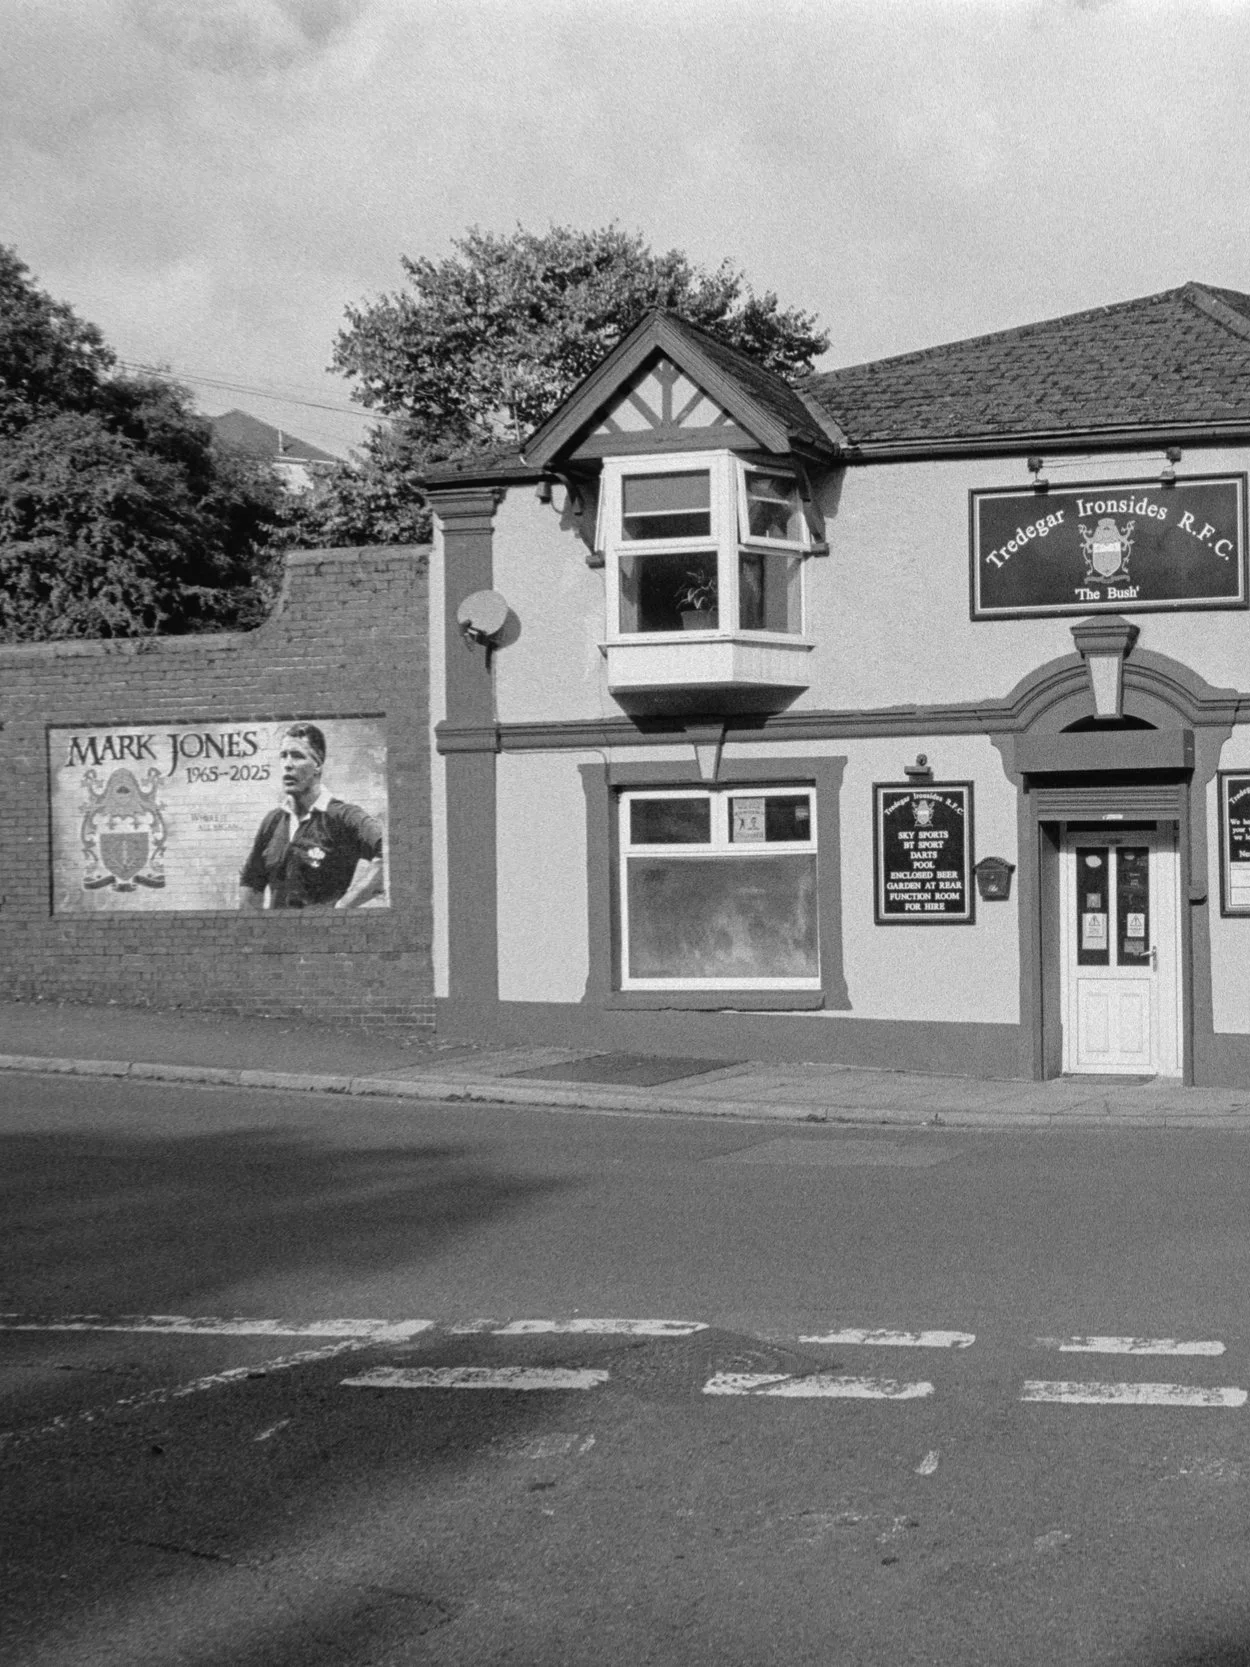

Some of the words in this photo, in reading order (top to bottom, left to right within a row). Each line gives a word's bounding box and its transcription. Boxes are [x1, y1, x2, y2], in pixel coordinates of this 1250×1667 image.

[986, 509, 1065, 568] Tredegar
[1076, 496, 1168, 520] Ironsides
[65, 734, 157, 767] MARK
[167, 731, 258, 777] JONES
[913, 793, 943, 802] Ironsides
[1230, 818, 1241, 826] We
[898, 831, 915, 840] SKY
[918, 830, 949, 839] SPORTS
[903, 841, 915, 850] BT
[918, 840, 944, 849] SPORT
[910, 851, 938, 859] DARTS
[913, 861, 935, 869] POOL
[890, 871, 933, 880] ENCLOSED
[936, 871, 958, 879] BEER
[886, 881, 921, 890] GARDEN
[924, 881, 937, 890] AT
[939, 880, 963, 889] REAR
[889, 892, 931, 901] FUNCTION
[935, 891, 960, 900] ROOM
[905, 902, 922, 911] FOR
[924, 902, 946, 911] HIRE
